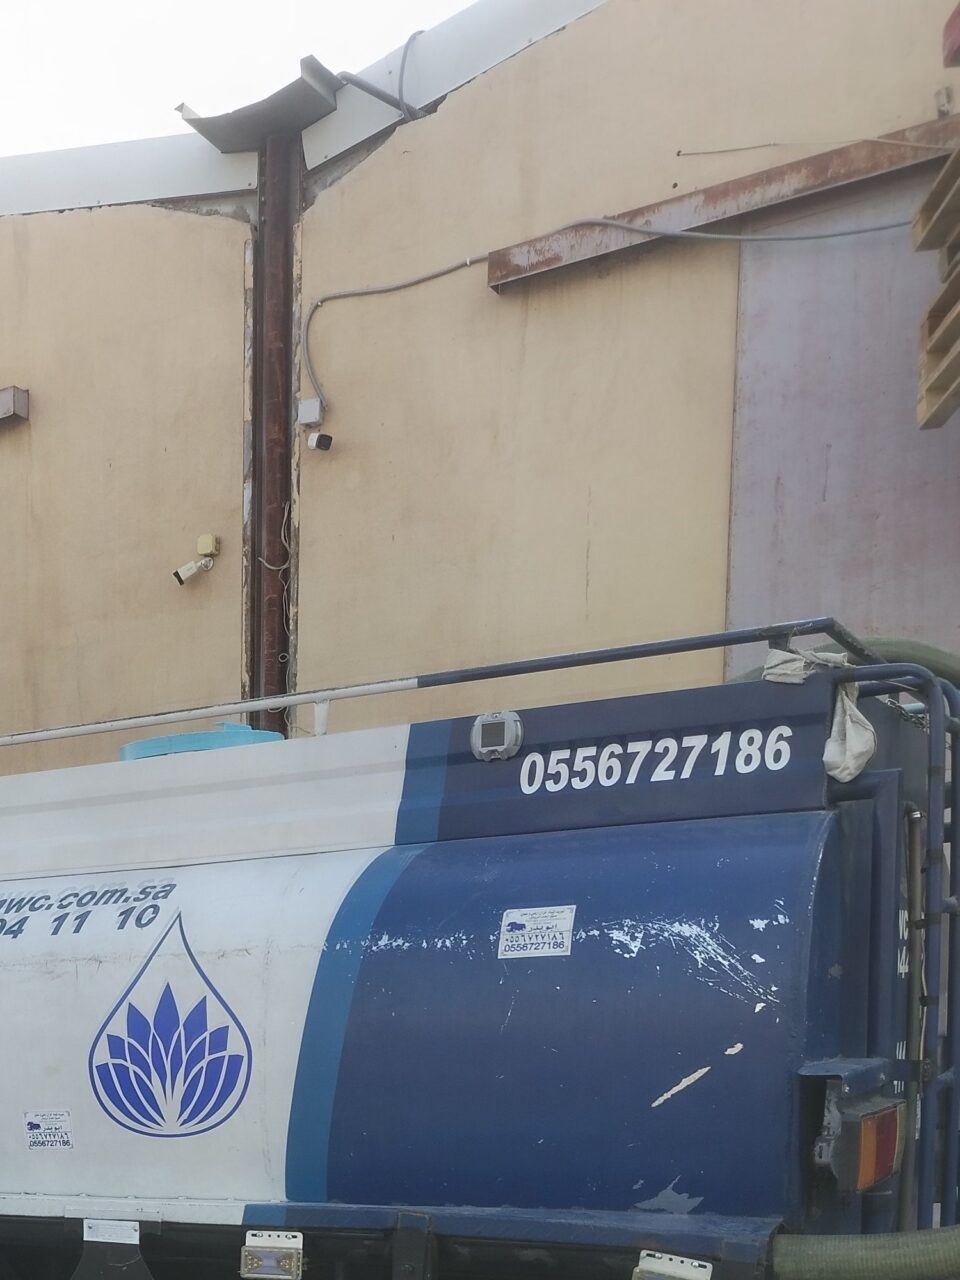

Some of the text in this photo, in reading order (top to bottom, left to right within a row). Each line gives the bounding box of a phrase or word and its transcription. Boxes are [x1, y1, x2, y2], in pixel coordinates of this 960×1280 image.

[520, 725, 793, 795] 0556727186
[51, 910, 92, 936] 11
[117, 904, 160, 930] 10
